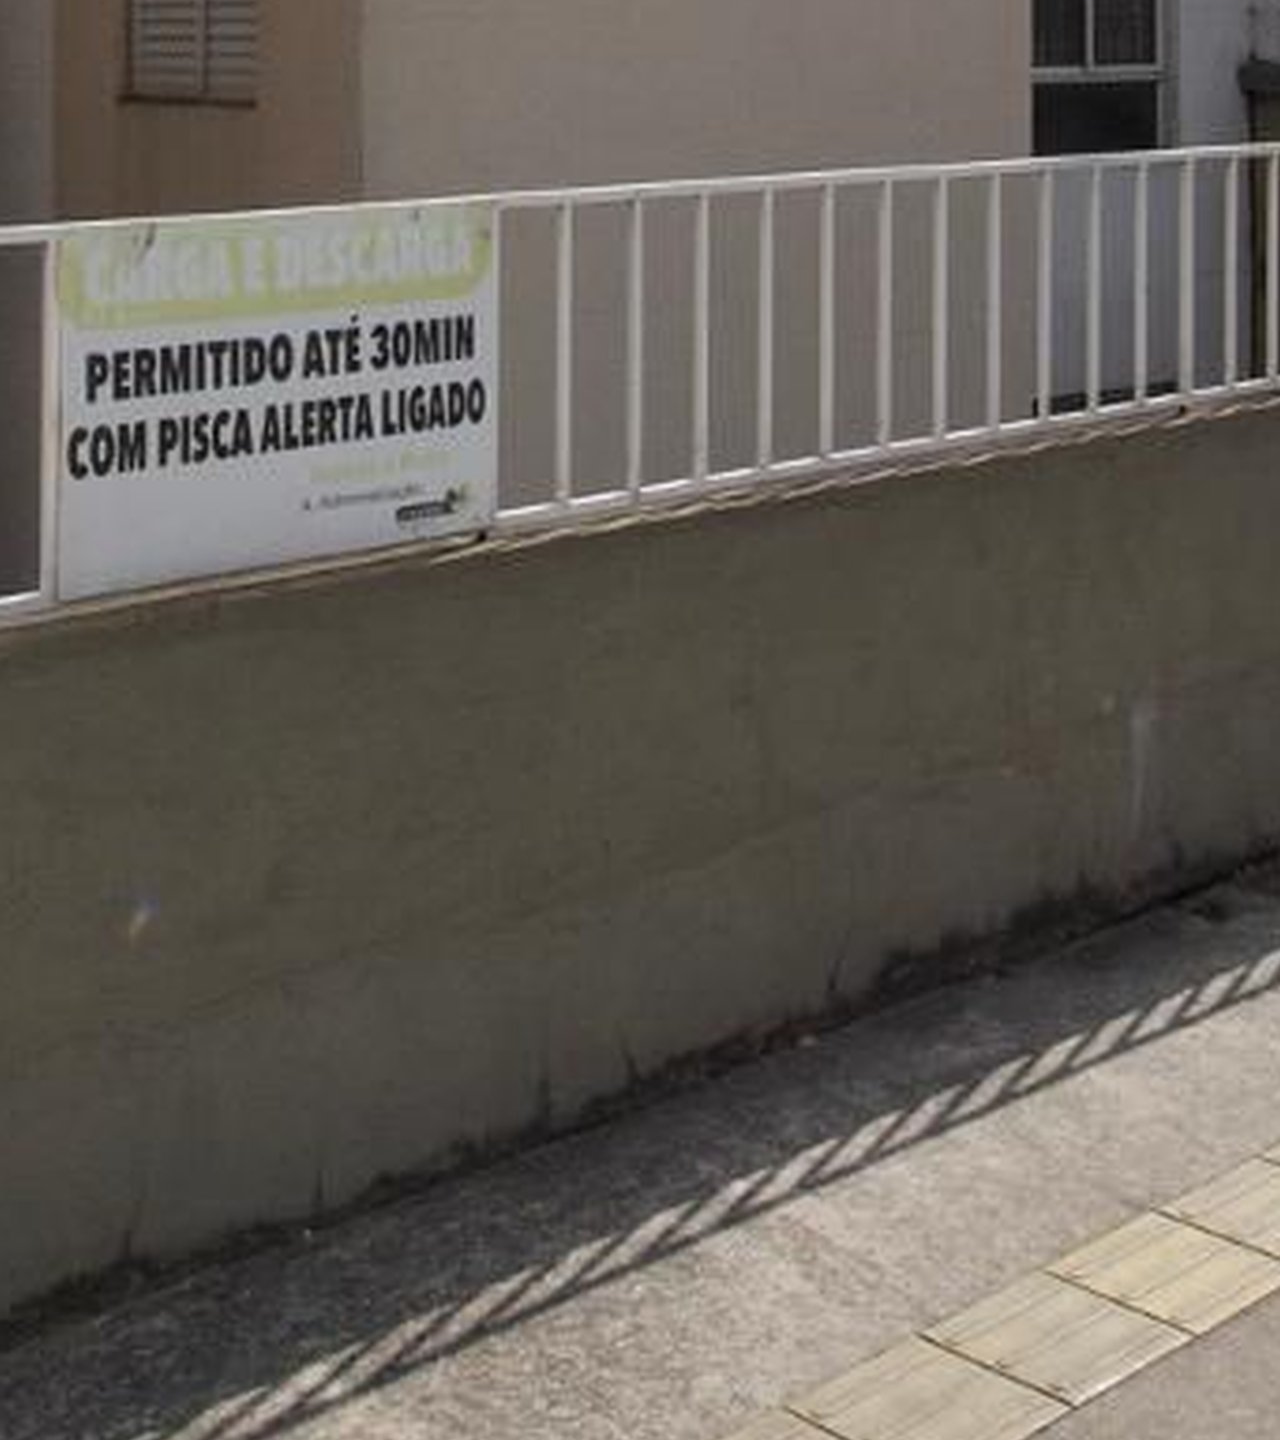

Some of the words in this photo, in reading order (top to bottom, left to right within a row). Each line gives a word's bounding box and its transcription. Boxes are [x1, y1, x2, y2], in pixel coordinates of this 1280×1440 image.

[84, 332, 295, 405] PERMITIDO
[301, 313, 363, 381] ATÉ
[369, 313, 476, 372] 30MIN
[65, 418, 148, 481] COM
[157, 407, 255, 469] PISCA
[258, 392, 376, 456] ALERTA
[380, 376, 487, 437] LIGADO
